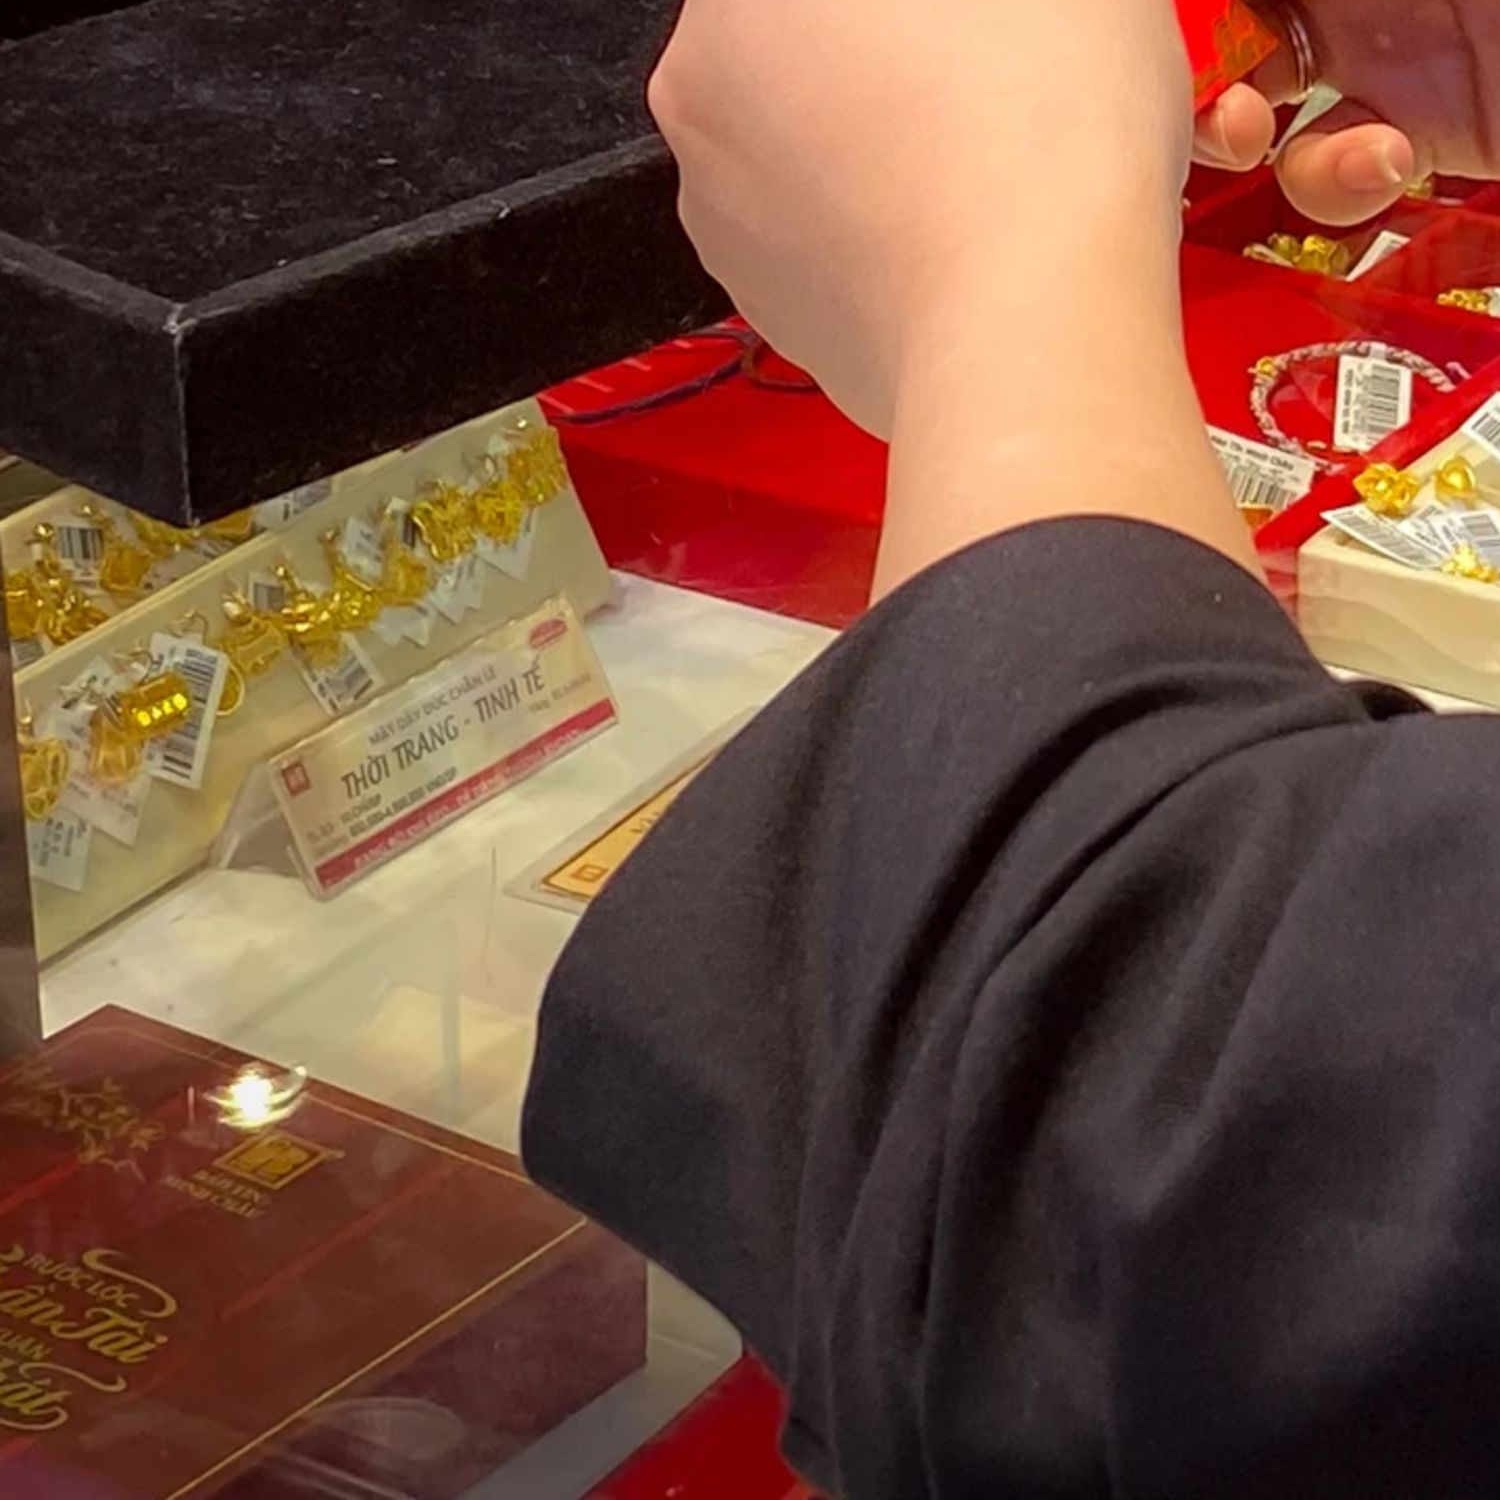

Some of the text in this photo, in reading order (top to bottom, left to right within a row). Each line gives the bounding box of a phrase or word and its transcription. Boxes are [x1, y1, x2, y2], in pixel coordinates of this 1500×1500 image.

[341, 754, 391, 799] THỜI
[391, 714, 460, 771] TRANG
[472, 676, 520, 724] TINH
